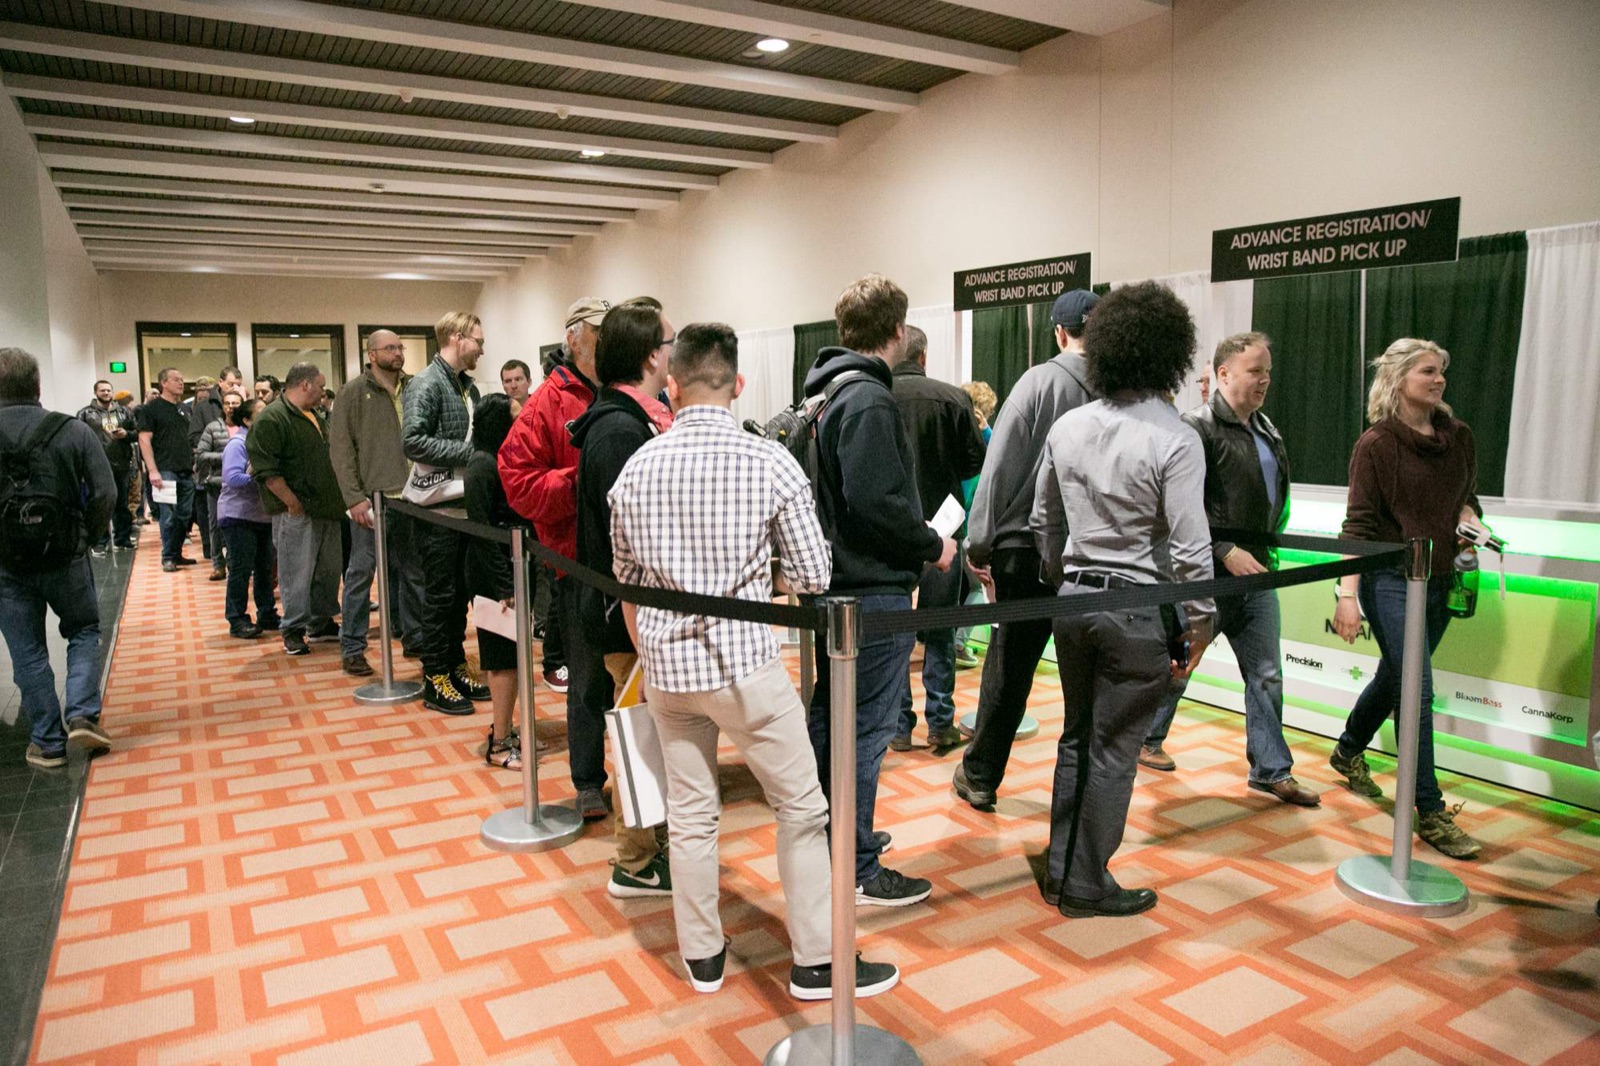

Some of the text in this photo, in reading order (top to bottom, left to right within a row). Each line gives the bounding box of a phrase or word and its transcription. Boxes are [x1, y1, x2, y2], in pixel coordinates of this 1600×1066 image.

[1231, 209, 1432, 250] ADVANCE REGISTRATION/
[1247, 238, 1408, 271] WRIST BAND PICK UP
[964, 260, 1077, 287] ADVANCE REGISTRATION/
[974, 281, 1065, 303] WRIST BAND PICK UP
[1285, 653, 1323, 669] Precision
[1521, 705, 1574, 724] CannaKorp
